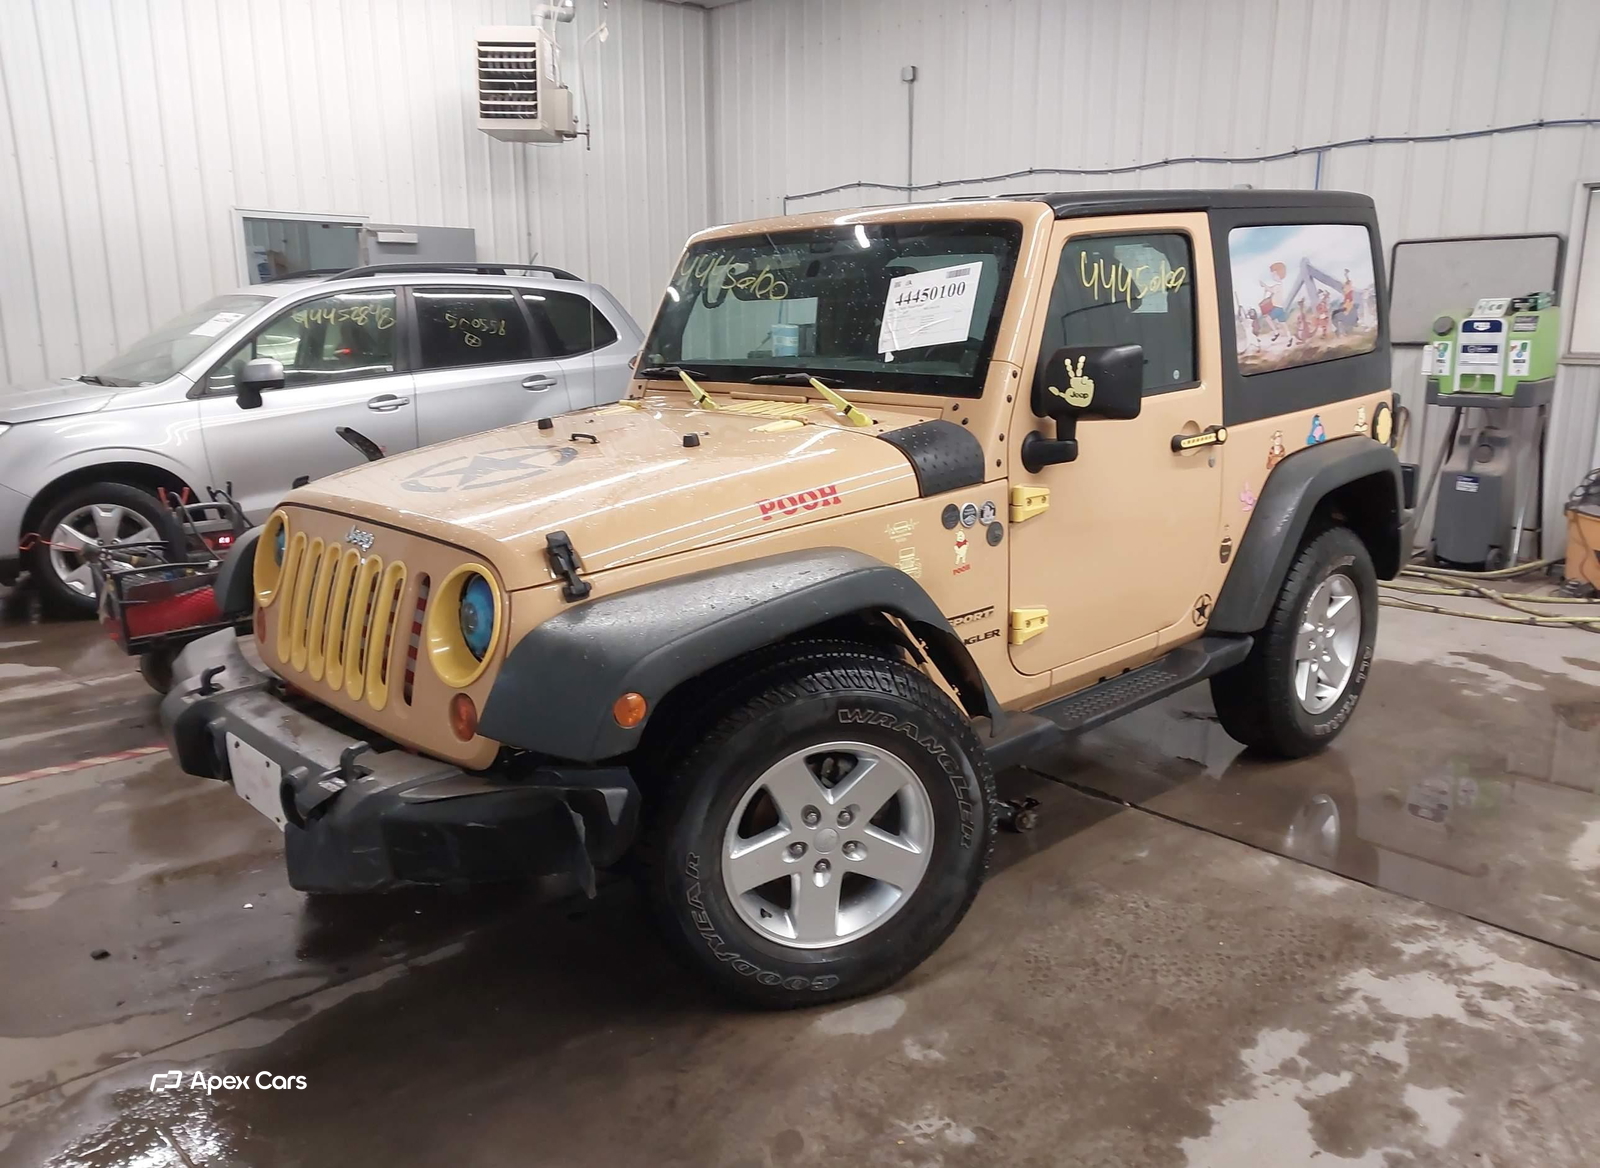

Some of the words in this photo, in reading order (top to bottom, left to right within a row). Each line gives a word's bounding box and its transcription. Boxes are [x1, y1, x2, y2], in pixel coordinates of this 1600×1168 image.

[894, 281, 967, 306] 44450100
[754, 484, 842, 521] POOH
[345, 524, 375, 552] Jeep
[837, 708, 974, 850] WRANGLER
[685, 852, 840, 991] GOODYEAR
